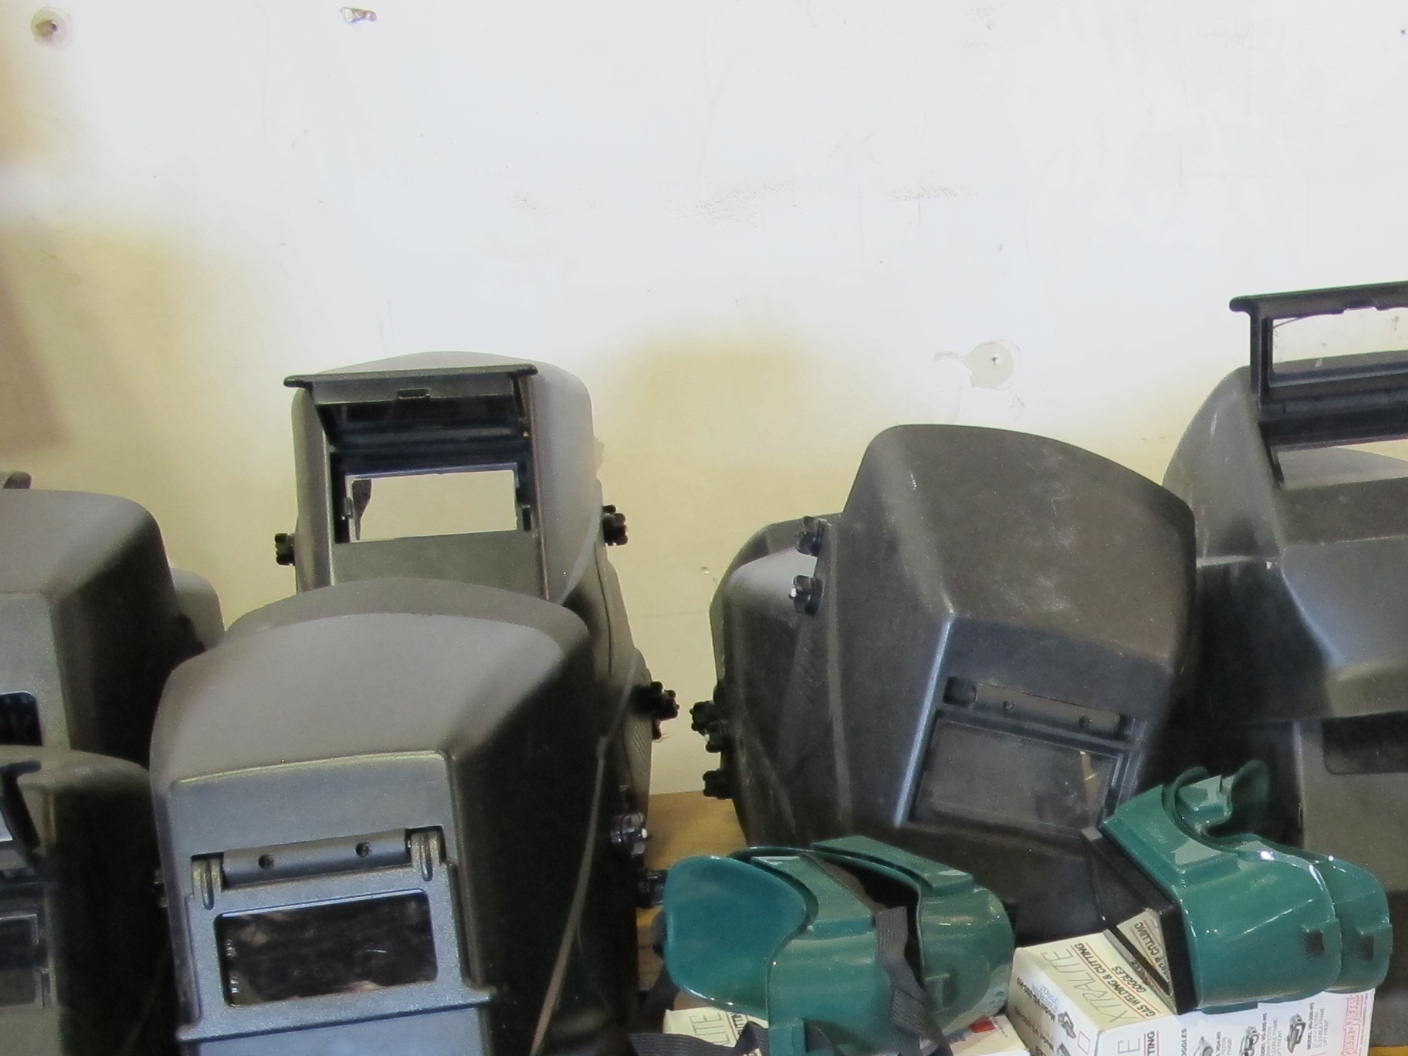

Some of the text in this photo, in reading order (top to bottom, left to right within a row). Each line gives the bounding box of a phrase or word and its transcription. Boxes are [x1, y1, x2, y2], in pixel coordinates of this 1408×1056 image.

[1075, 942, 1109, 976] CUTTING
[1042, 948, 1134, 1023] XTRALITE
[1112, 966, 1147, 993] GOGGLES
[1112, 982, 1140, 1011] WELDING
[1138, 1001, 1157, 1018] GAS
